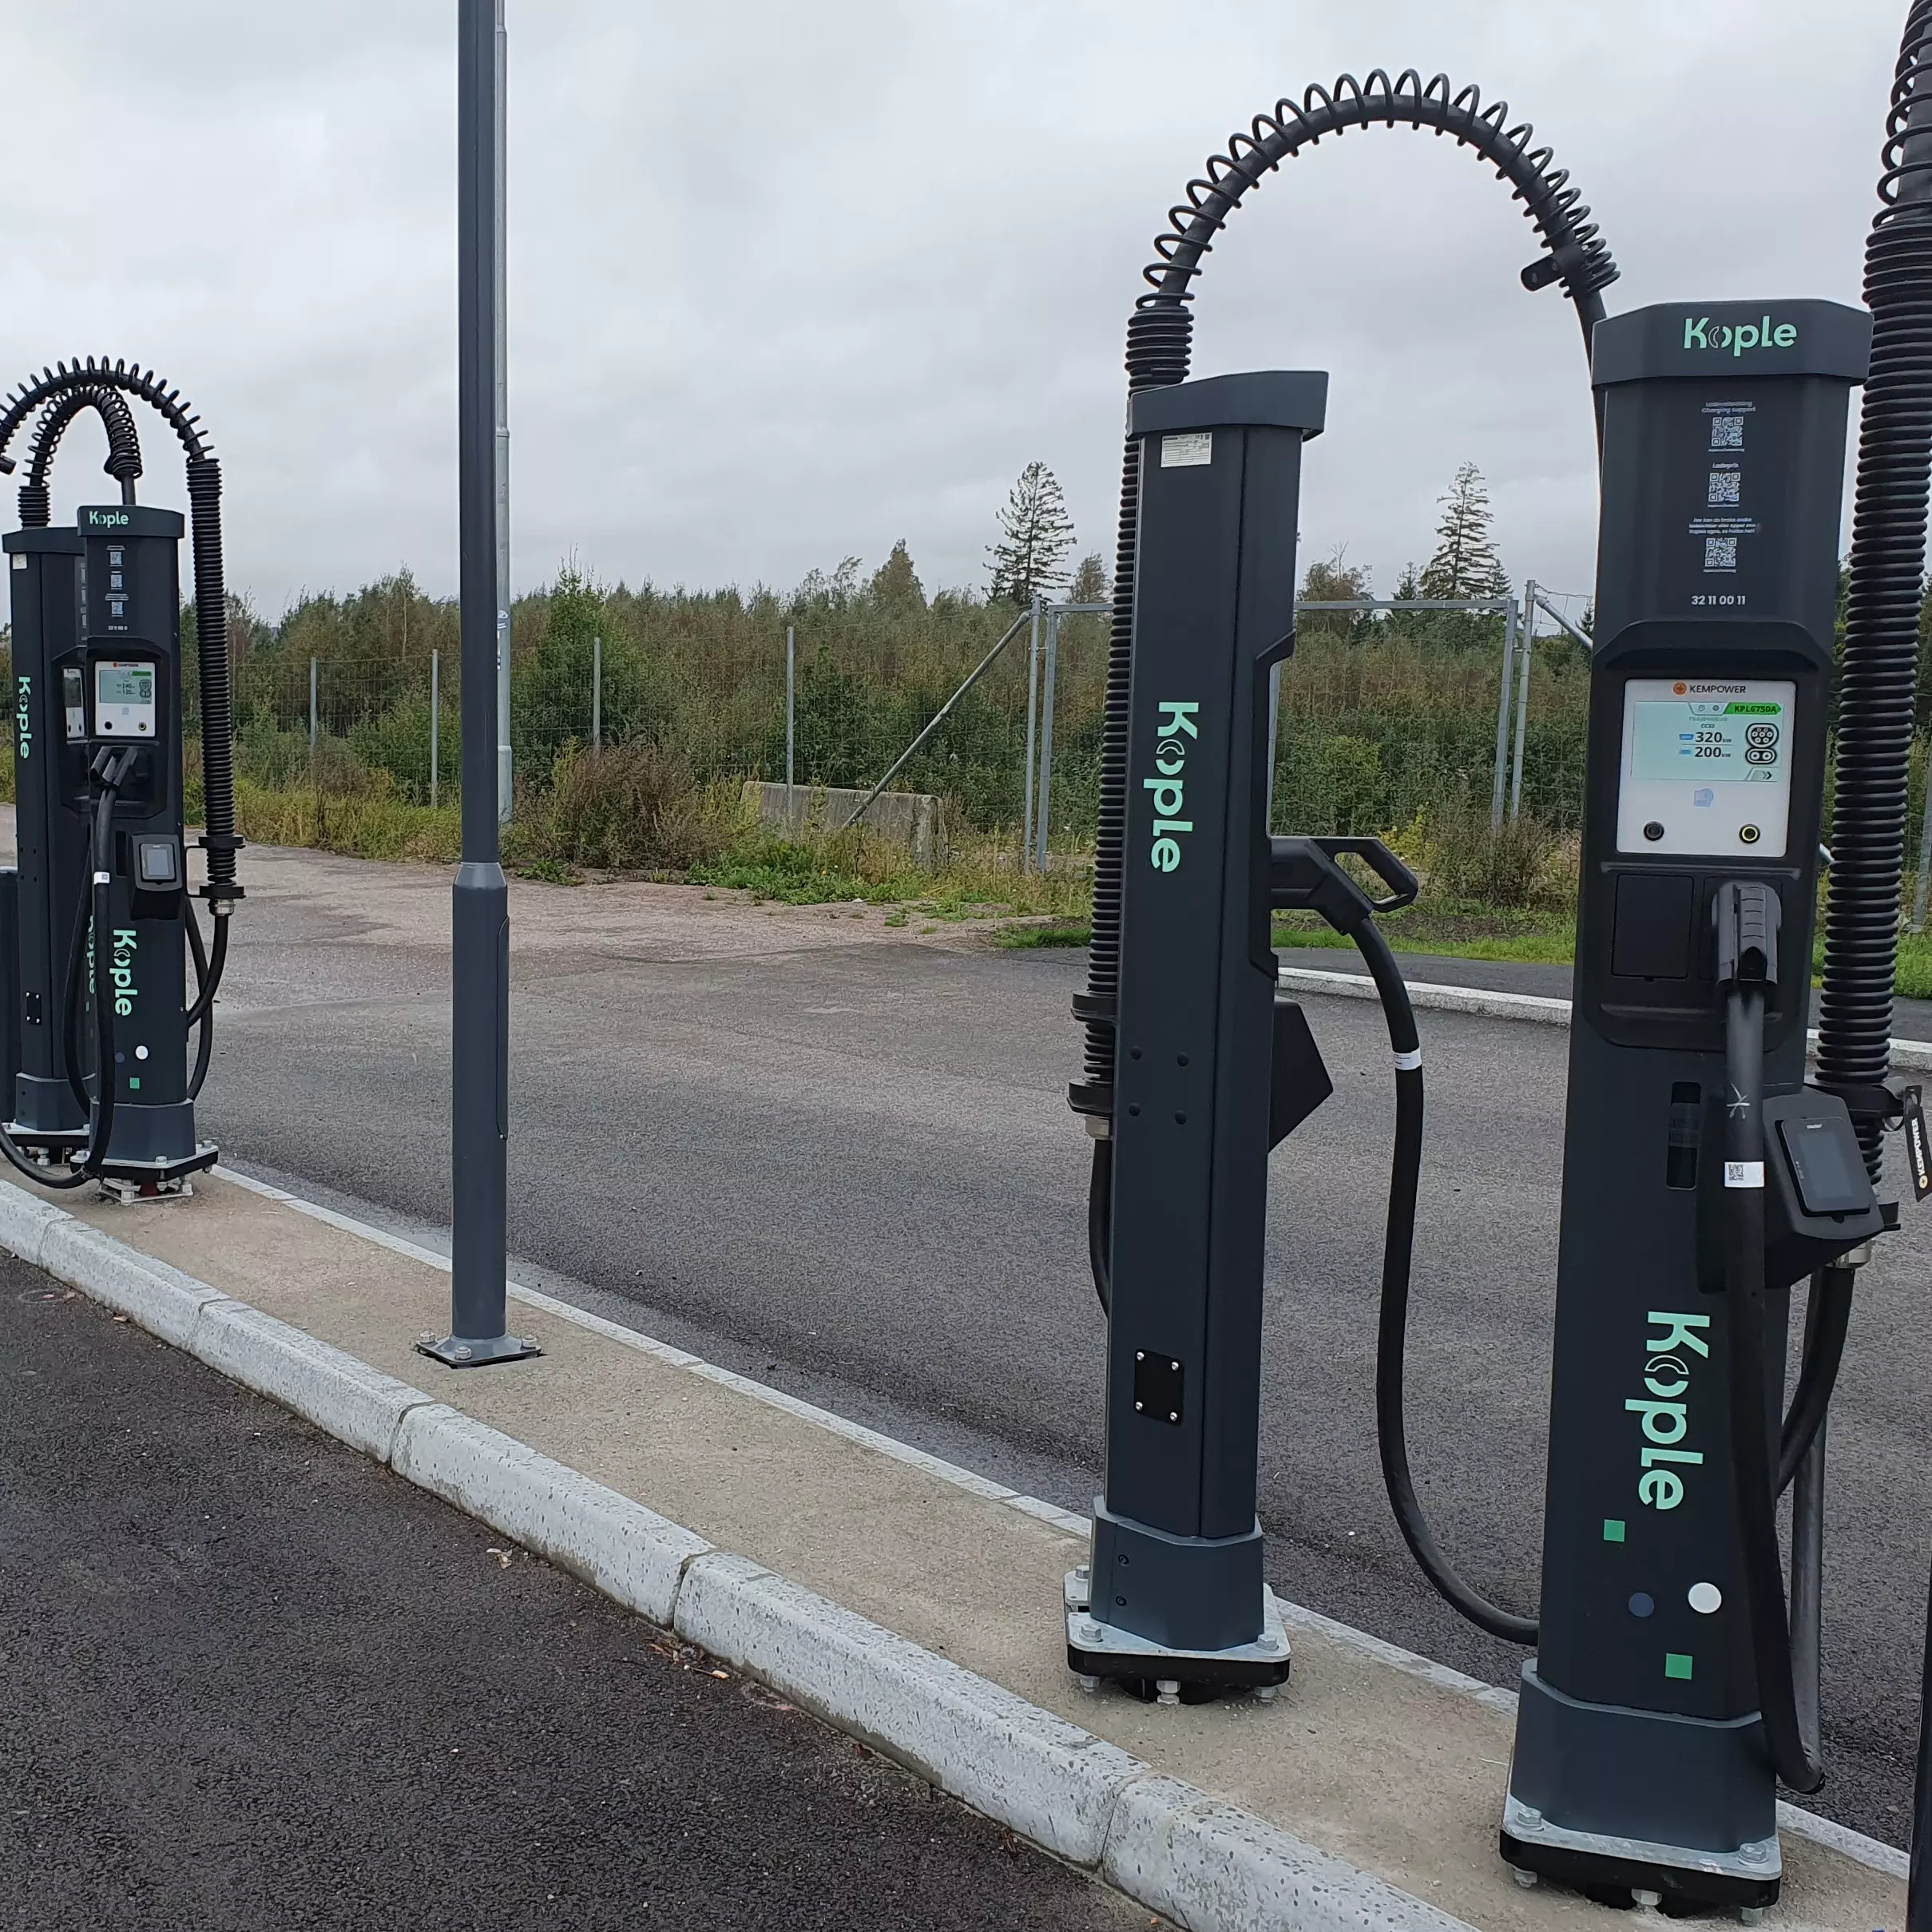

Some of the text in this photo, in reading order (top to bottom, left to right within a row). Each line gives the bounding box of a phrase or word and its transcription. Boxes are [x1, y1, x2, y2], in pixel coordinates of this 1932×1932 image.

[1684, 315, 1797, 357] Kople
[89, 510, 129, 529] Kople
[1691, 595, 1746, 605] 32 11 00 11
[1689, 684, 1747, 694] KEMPOWER
[16, 676, 33, 760] Kople
[1694, 746, 1722, 758] 200
[1695, 732, 1723, 743] 320
[1143, 701, 1200, 873] Kople
[109, 929, 138, 1017] Kople
[1625, 1311, 1711, 1509] Kople
